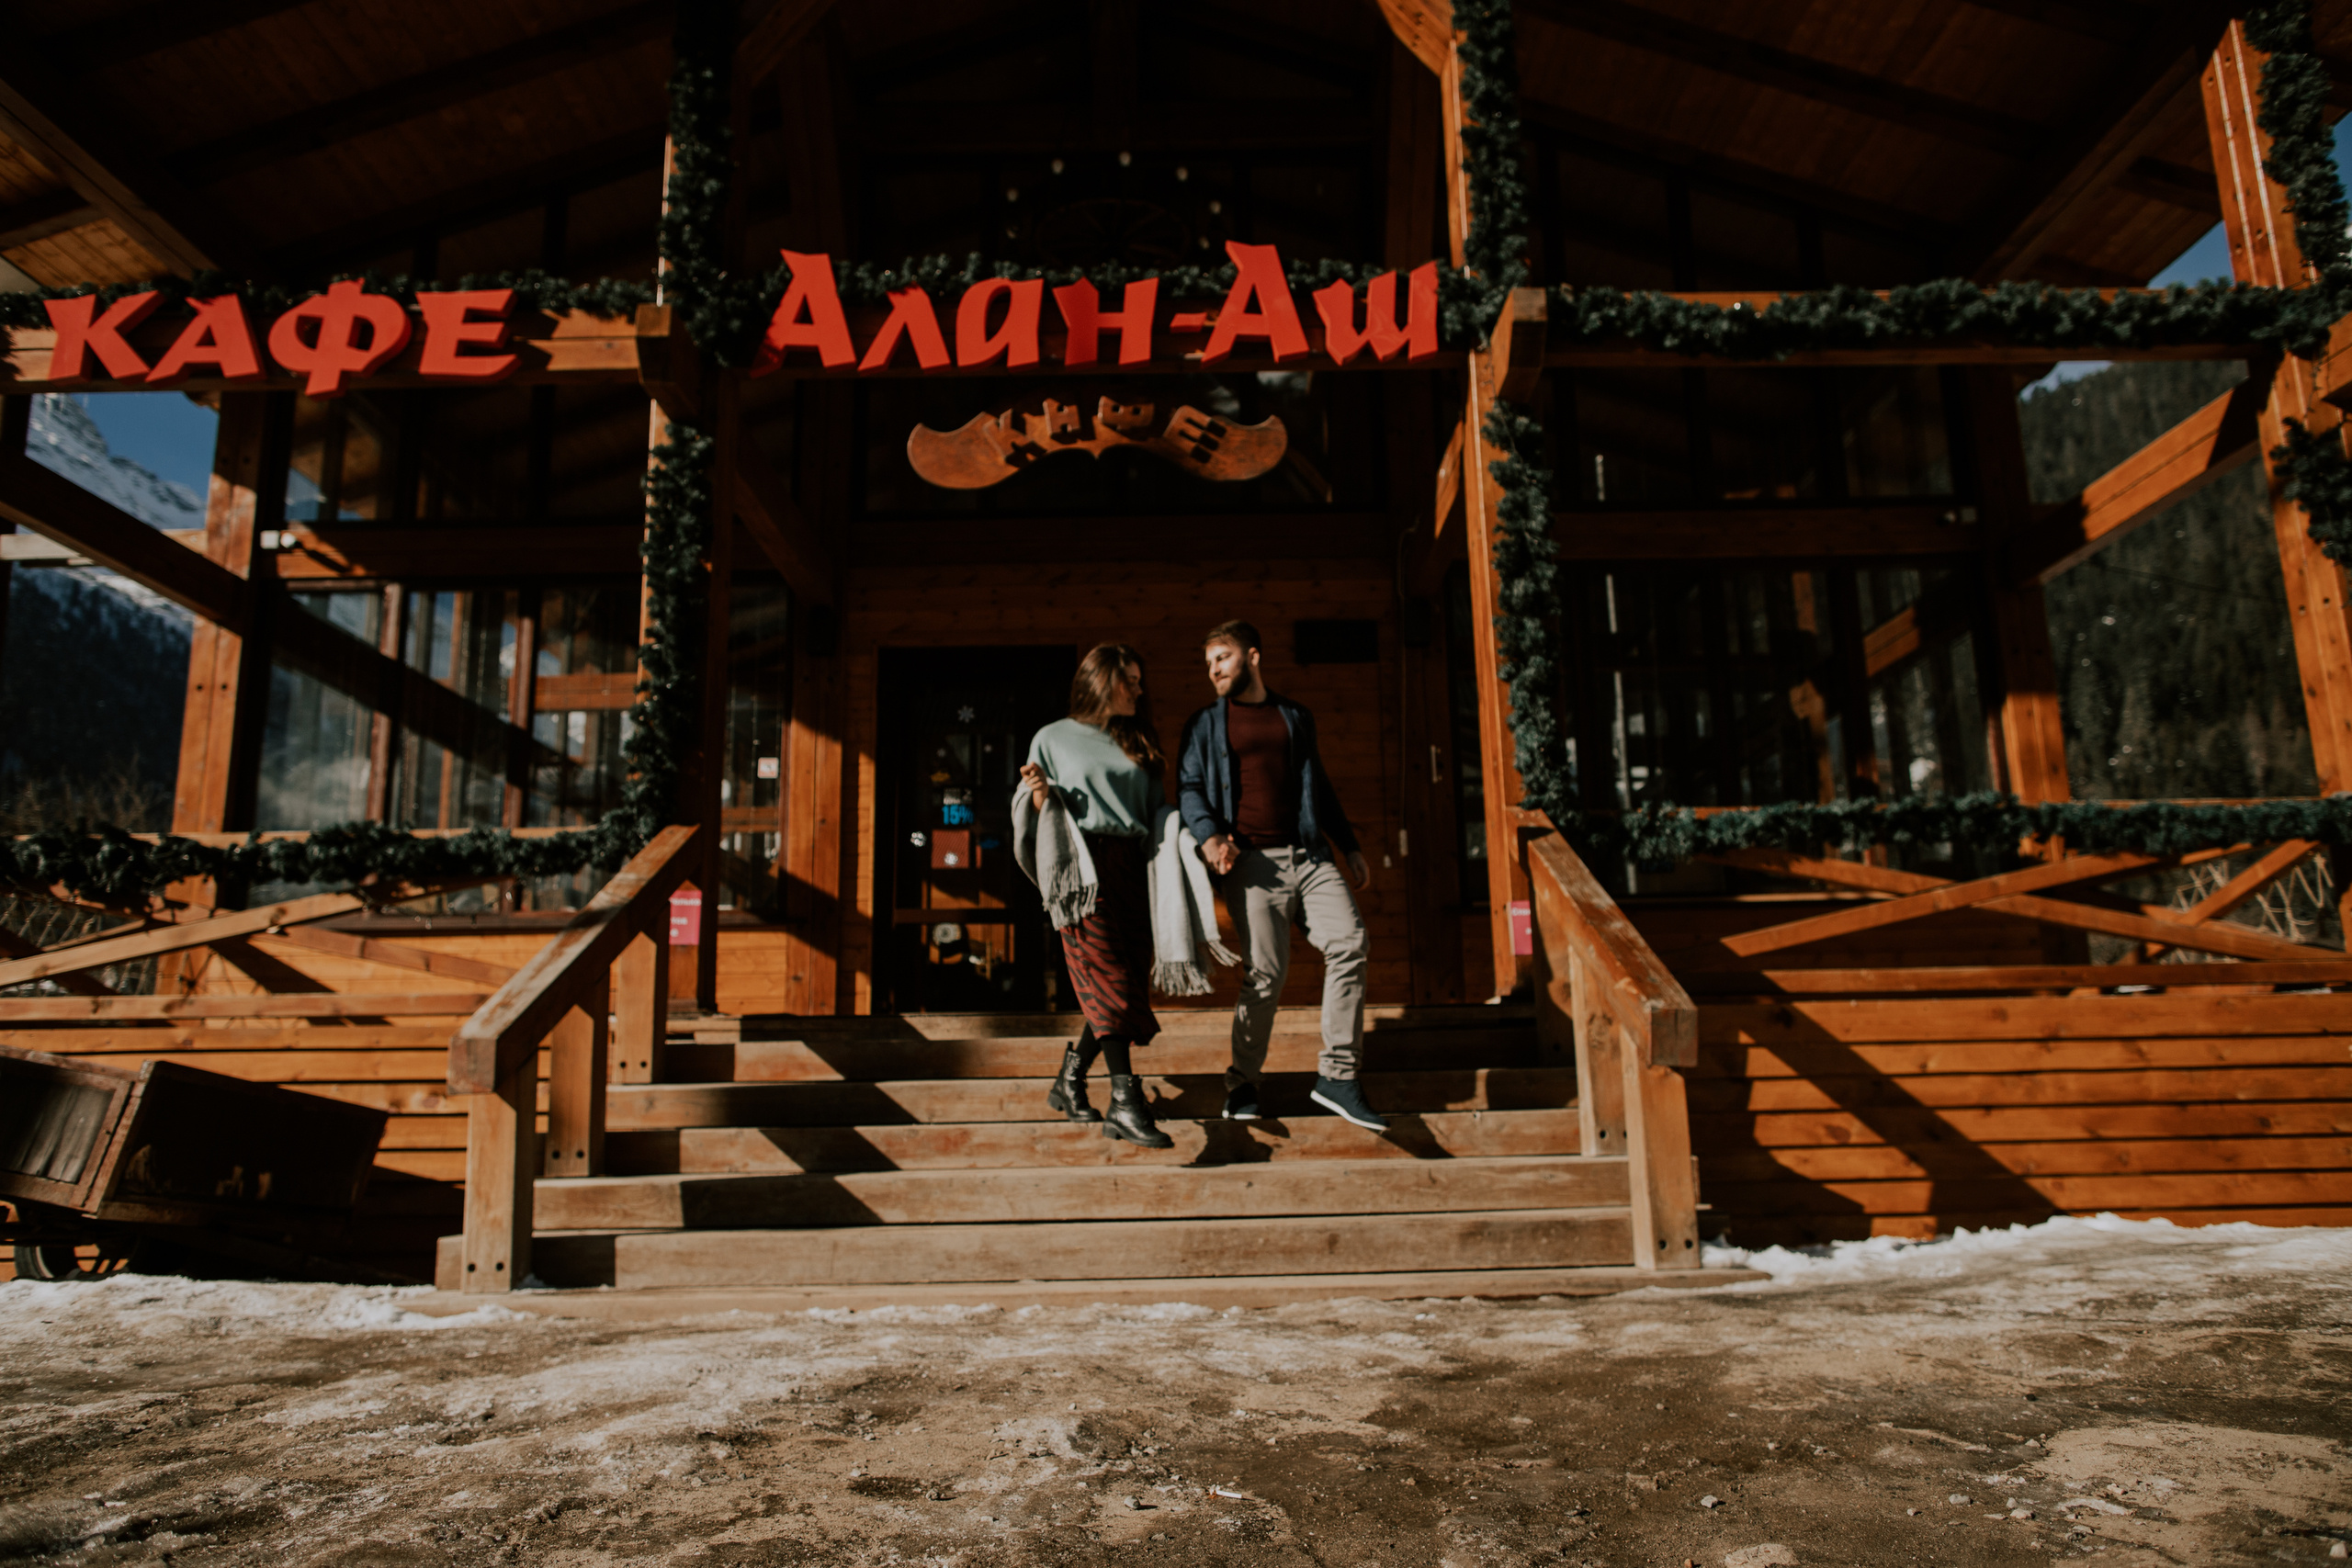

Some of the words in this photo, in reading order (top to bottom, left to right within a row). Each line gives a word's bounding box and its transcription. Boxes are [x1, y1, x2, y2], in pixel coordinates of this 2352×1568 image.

[44, 278, 521, 400] КАФЕ
[752, 241, 1440, 378] Алан-Аш
[942, 805, 975, 826] 15%
